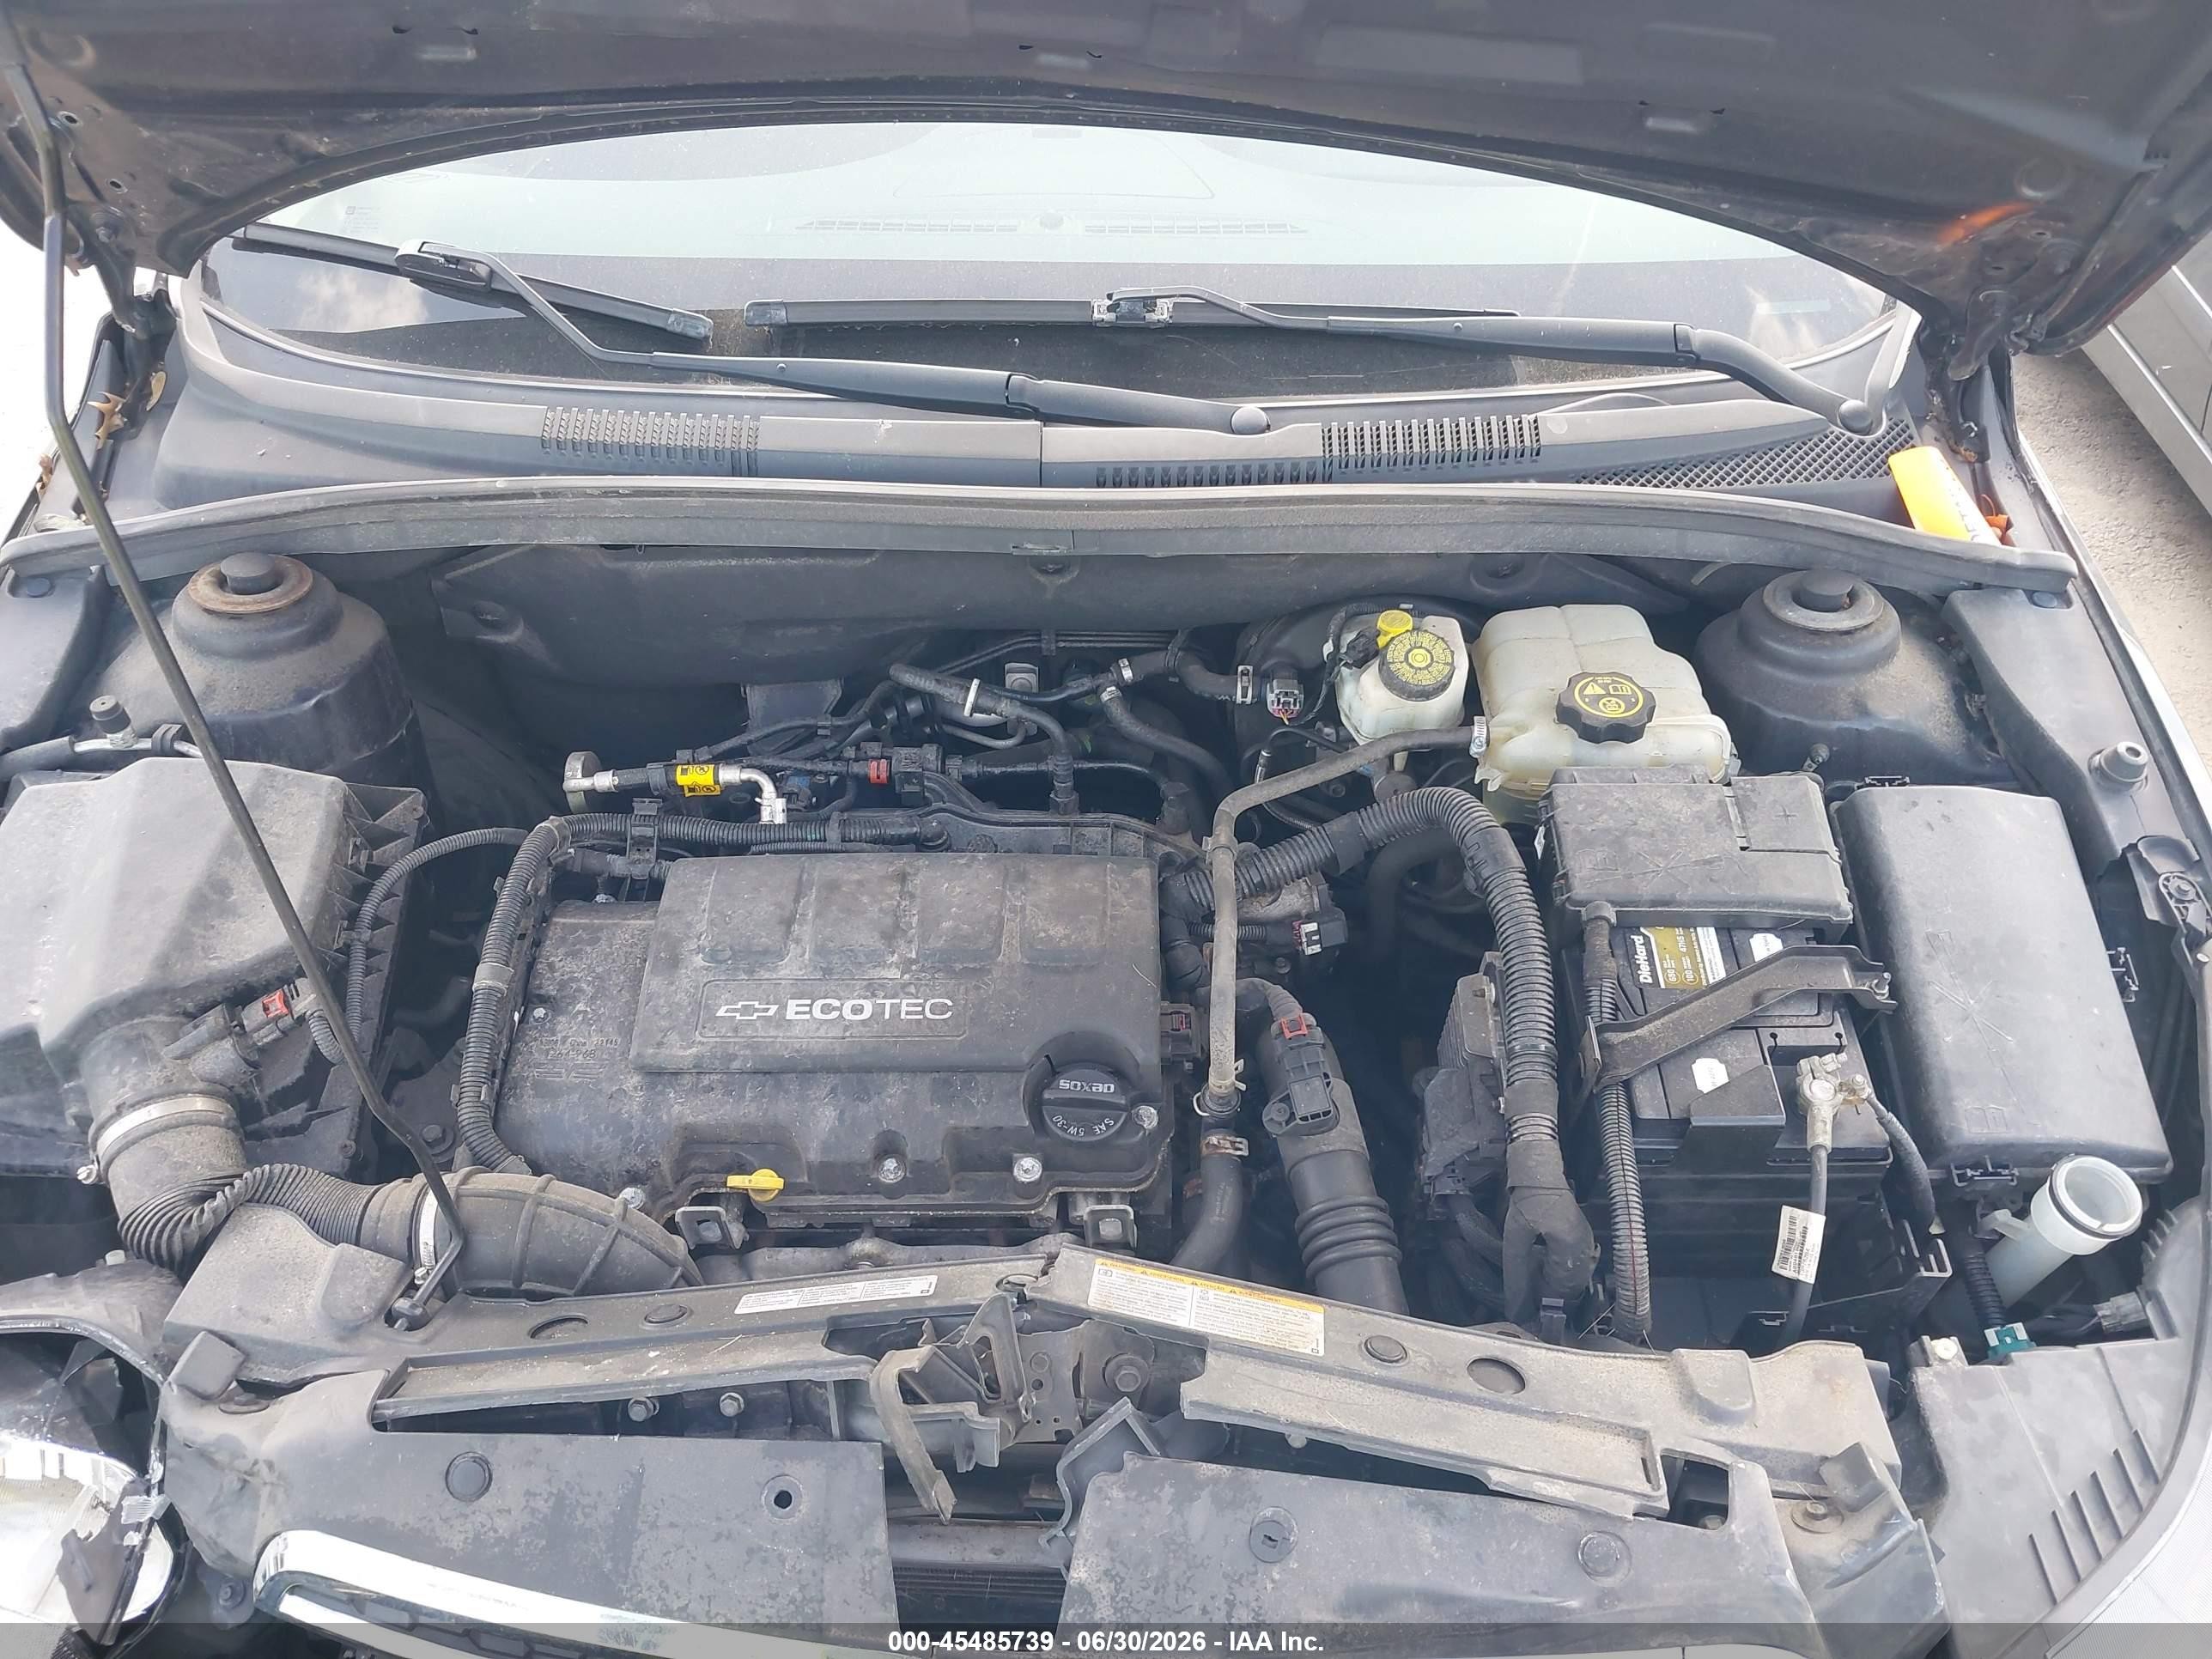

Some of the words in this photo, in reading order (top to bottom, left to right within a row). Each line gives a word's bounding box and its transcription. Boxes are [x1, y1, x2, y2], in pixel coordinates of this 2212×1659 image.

[1630, 934, 1652, 983] DieHard
[1667, 969, 1677, 981] 650
[1685, 969, 1695, 981] 100
[785, 998, 954, 1021] ECOTEC
[1059, 1079, 1115, 1093] dexos
[1052, 1115, 1086, 1137] 5W-30
[1091, 1117, 1115, 1135] SAE
